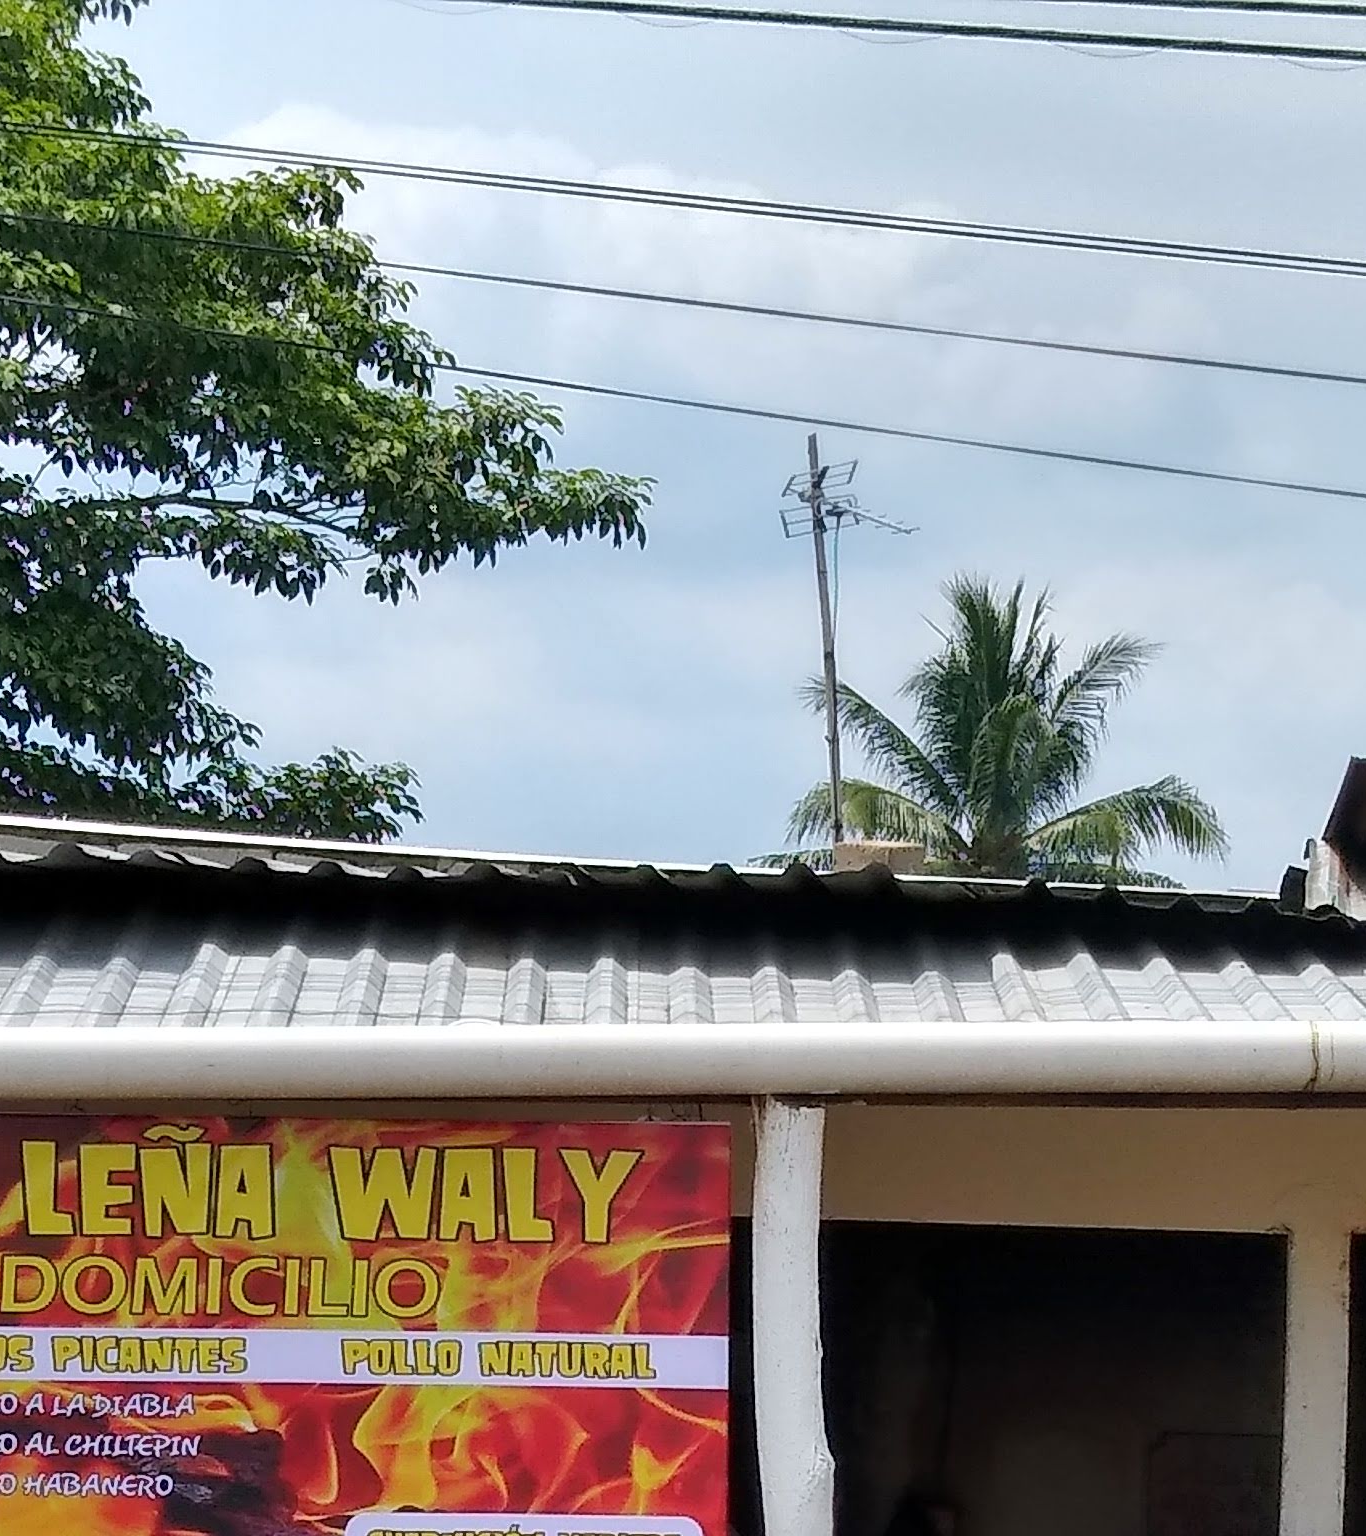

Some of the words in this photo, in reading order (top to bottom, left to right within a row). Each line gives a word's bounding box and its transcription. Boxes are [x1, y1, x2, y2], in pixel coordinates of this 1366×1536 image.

[21, 1122, 277, 1240] LEÑA
[328, 1143, 645, 1245] WALY
[50, 1334, 248, 1374] PICANTES
[341, 1338, 464, 1377] POLLO
[478, 1341, 657, 1380] NATURAL
[25, 1393, 45, 1416] A
[50, 1394, 85, 1417] LA
[91, 1393, 195, 1418] DIABLA
[24, 1433, 59, 1456] AL
[64, 1434, 201, 1457] CHILTEPIN
[23, 1473, 174, 1498] HABANERO
